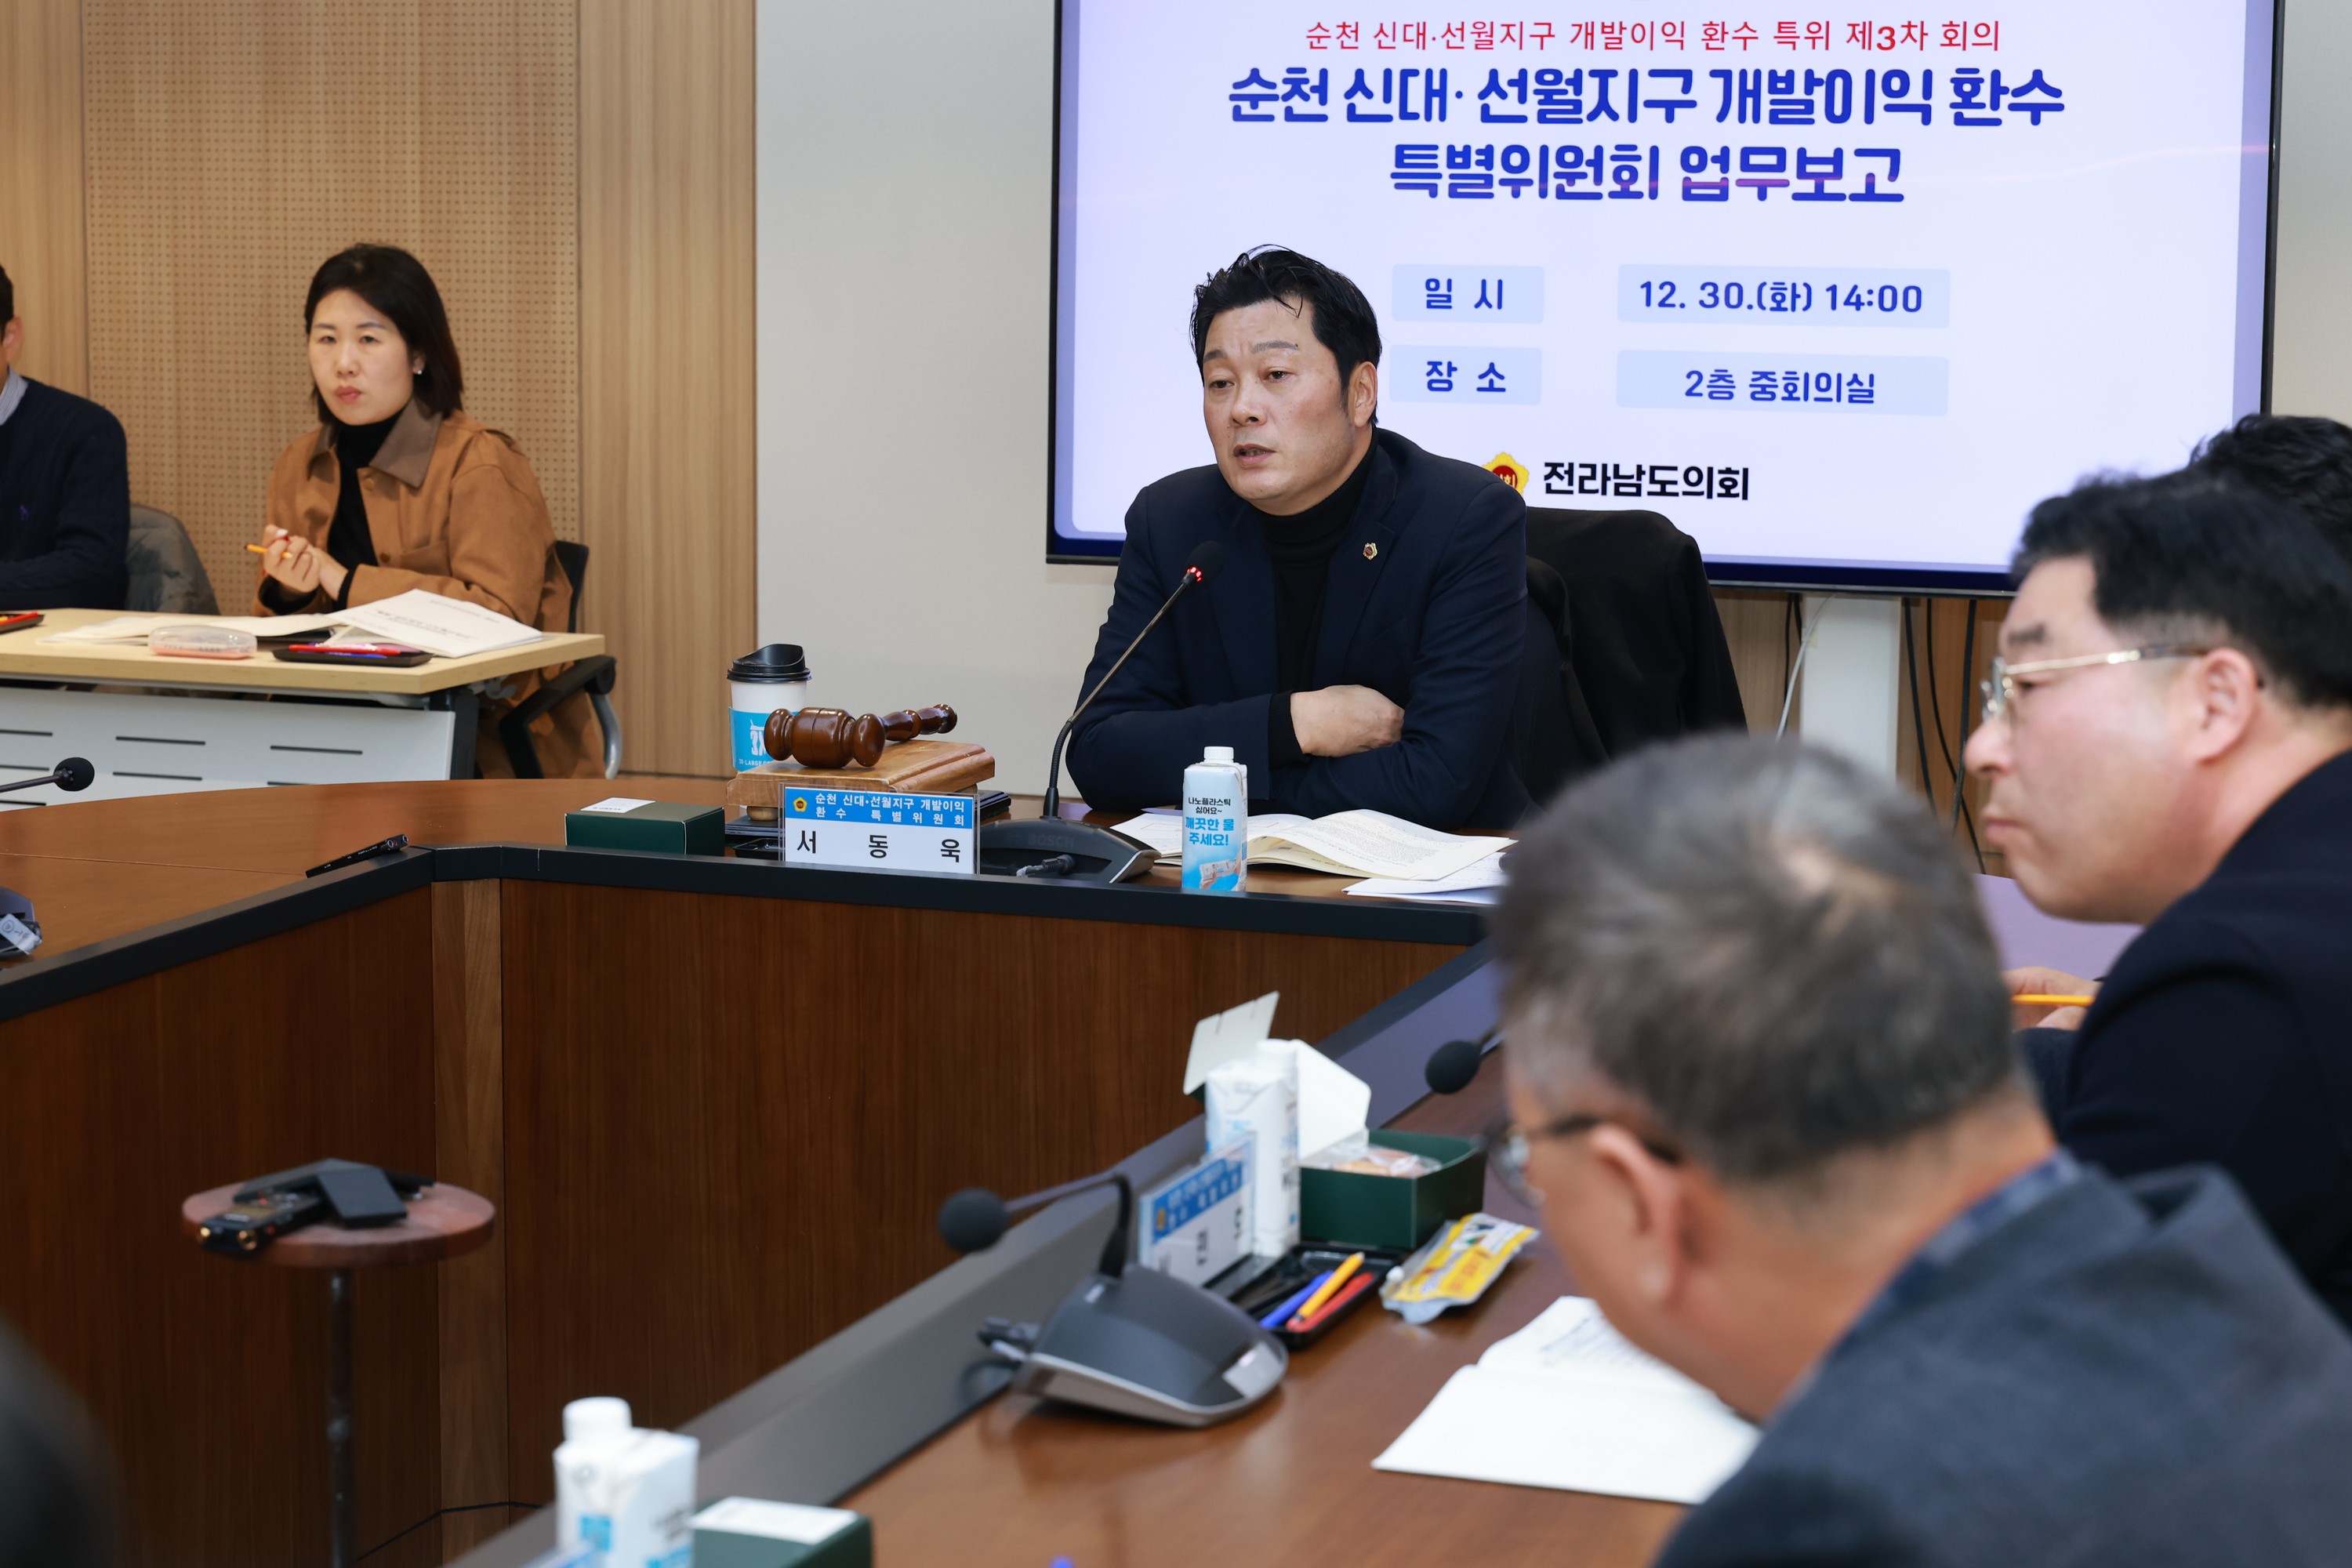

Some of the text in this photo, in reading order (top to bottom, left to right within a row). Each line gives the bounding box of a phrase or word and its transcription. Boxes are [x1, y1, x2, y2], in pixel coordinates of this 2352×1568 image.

[1306, 20, 1999, 52] 순천 신대·선월지구 개발이익 환수 특위 제3차 회의
[1229, 67, 1329, 123] 순천
[1477, 67, 1697, 125] 선월지구
[1708, 68, 1933, 126] 개발이익
[1949, 67, 2065, 127] 환수
[1390, 143, 1904, 202] 특별위원회 업무보고
[1425, 278, 1504, 310] 일 시
[1639, 281, 1922, 313] 12. 30.(화) 14:00
[1425, 360, 1507, 393] 장 소
[1684, 368, 1875, 405] 2층 중회의실
[1544, 462, 1749, 501] 전라남도의회
[815, 793, 837, 805] 순천
[920, 799, 965, 812] 개발이익
[815, 807, 964, 826] 환 수 특 별 위 원 회
[1188, 797, 1231, 806] 나노플라스틱
[1185, 816, 1234, 831] 깨끗한 물
[1189, 833, 1229, 846] 주세요!
[797, 830, 960, 862] 서 동 욱
[1028, 833, 1074, 848] BOSCH
